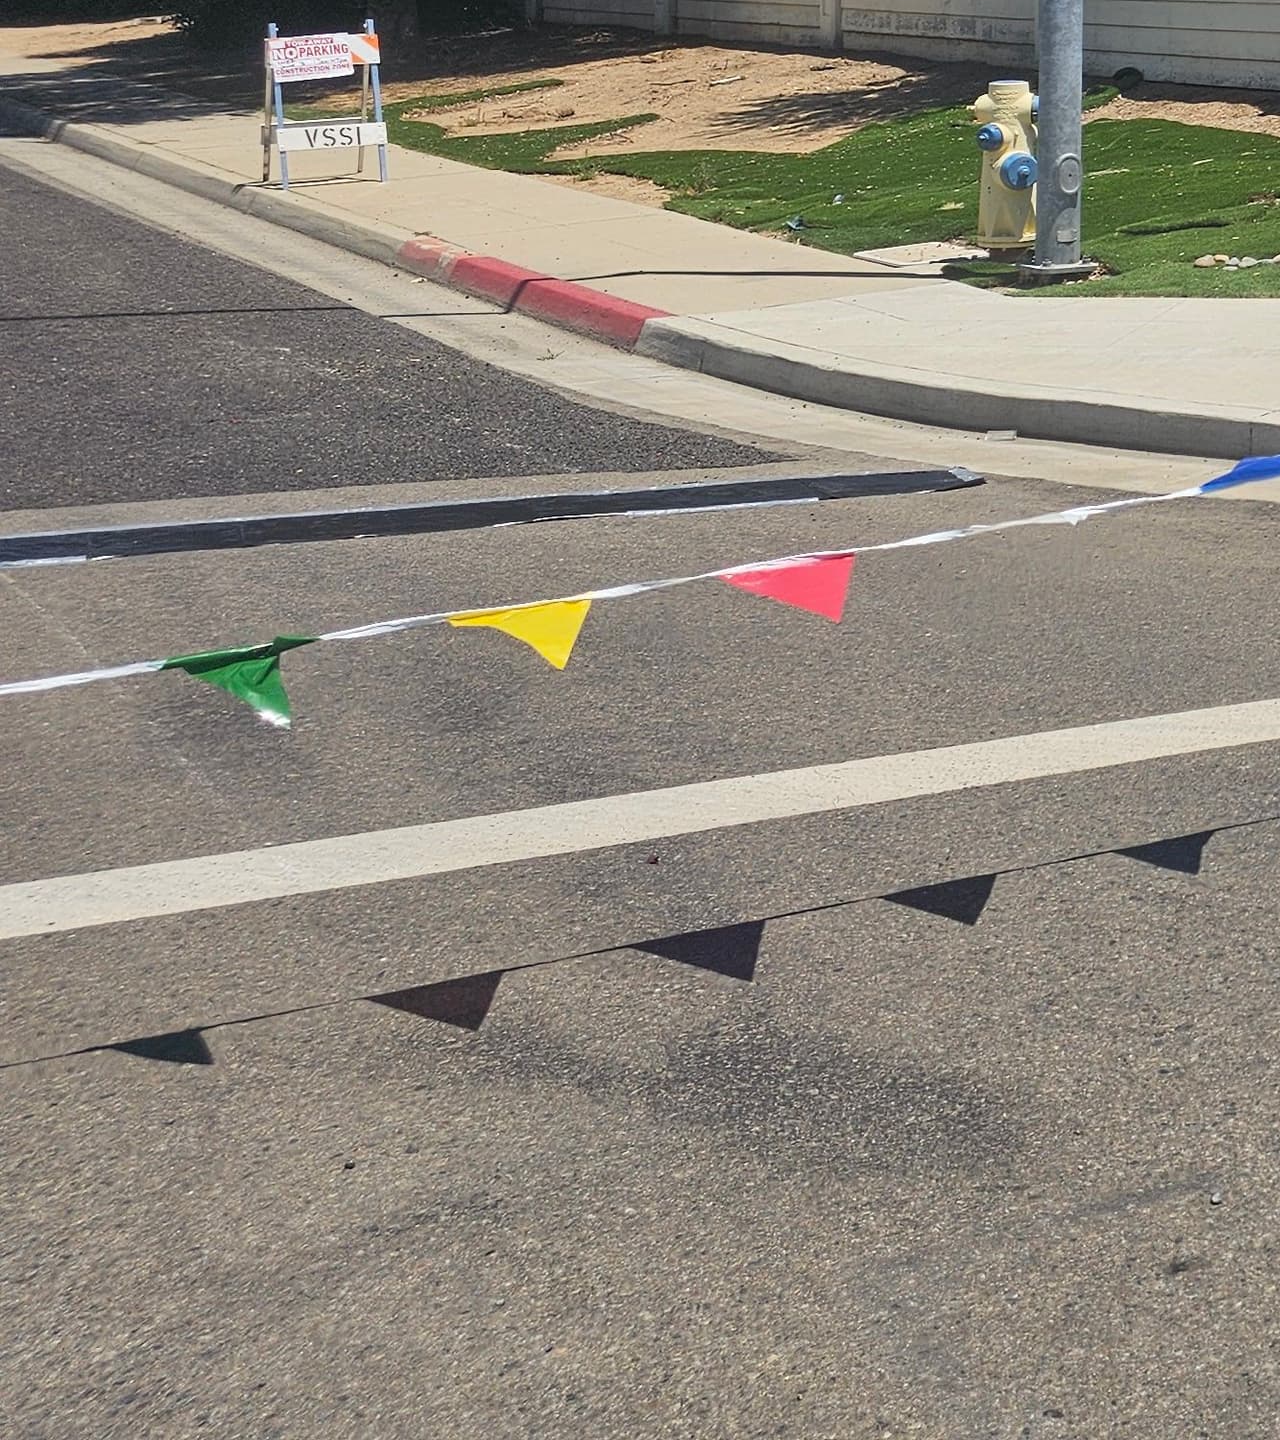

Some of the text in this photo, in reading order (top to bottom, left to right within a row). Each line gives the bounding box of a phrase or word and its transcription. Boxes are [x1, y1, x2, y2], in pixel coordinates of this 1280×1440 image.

[272, 43, 350, 60] NO PARKING
[275, 65, 330, 76] CONSTRUCTION
[305, 126, 361, 148] VSSI
